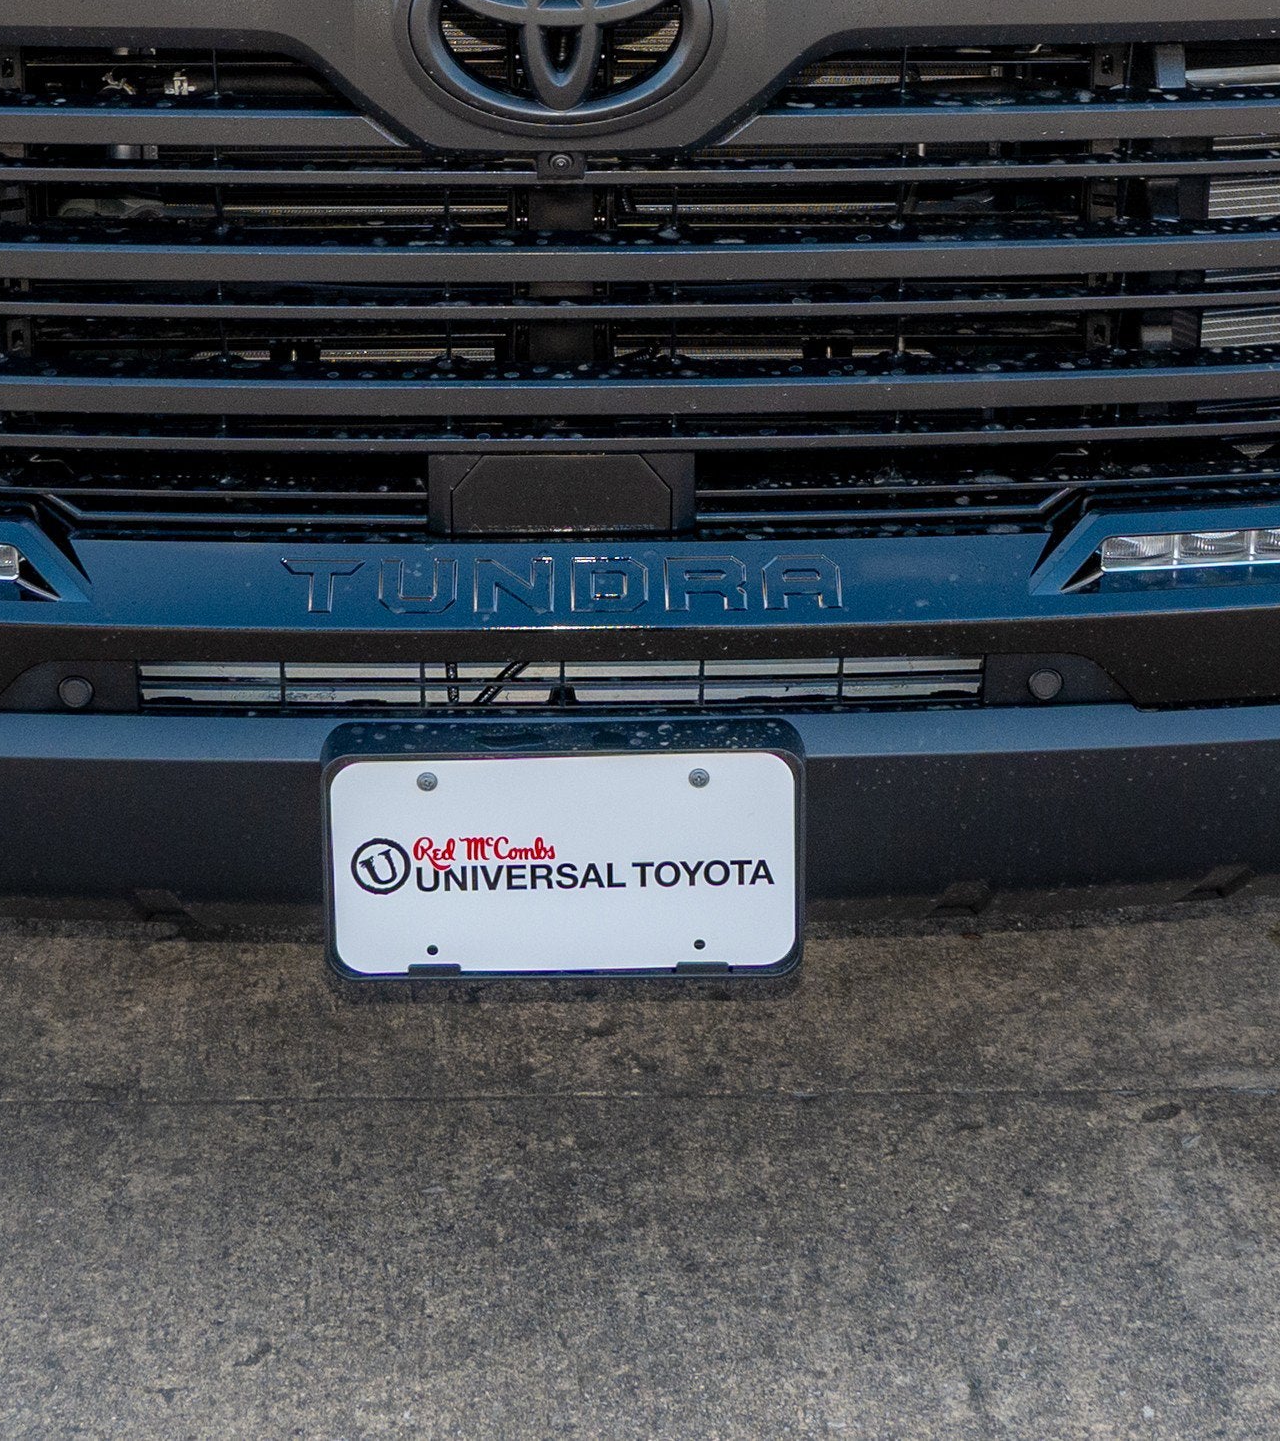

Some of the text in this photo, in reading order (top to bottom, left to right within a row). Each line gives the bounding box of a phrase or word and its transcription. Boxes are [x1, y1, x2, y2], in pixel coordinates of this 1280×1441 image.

[279, 554, 844, 614] TUNDRA
[413, 836, 556, 870] Red McCombs
[416, 859, 775, 892] UNIVERSAL TOYOTA
